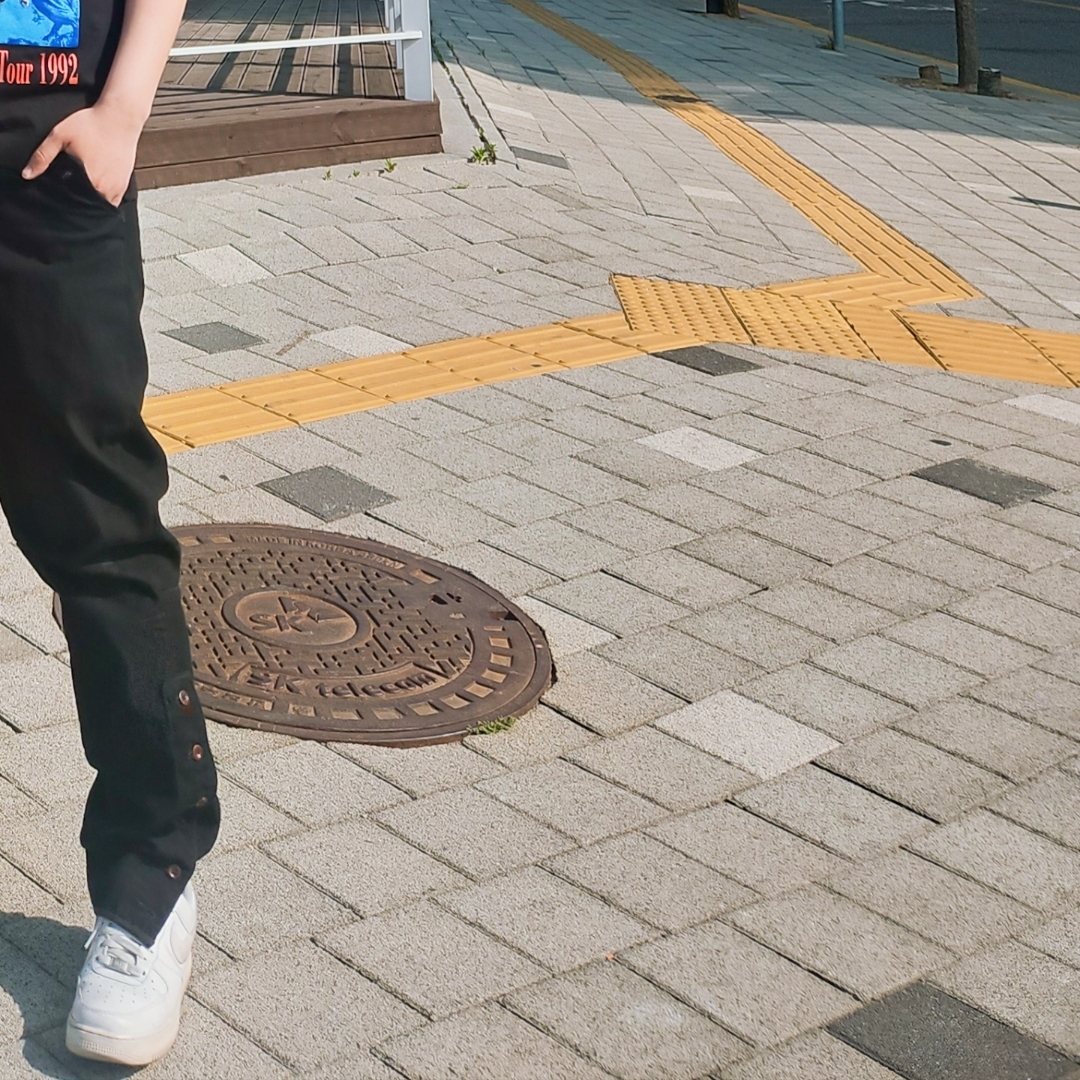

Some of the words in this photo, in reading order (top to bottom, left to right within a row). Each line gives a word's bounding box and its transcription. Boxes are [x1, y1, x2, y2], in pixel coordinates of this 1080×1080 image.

[39, 52, 79, 86] 1992
[247, 670, 306, 695] SK
[315, 672, 438, 699] telecom
